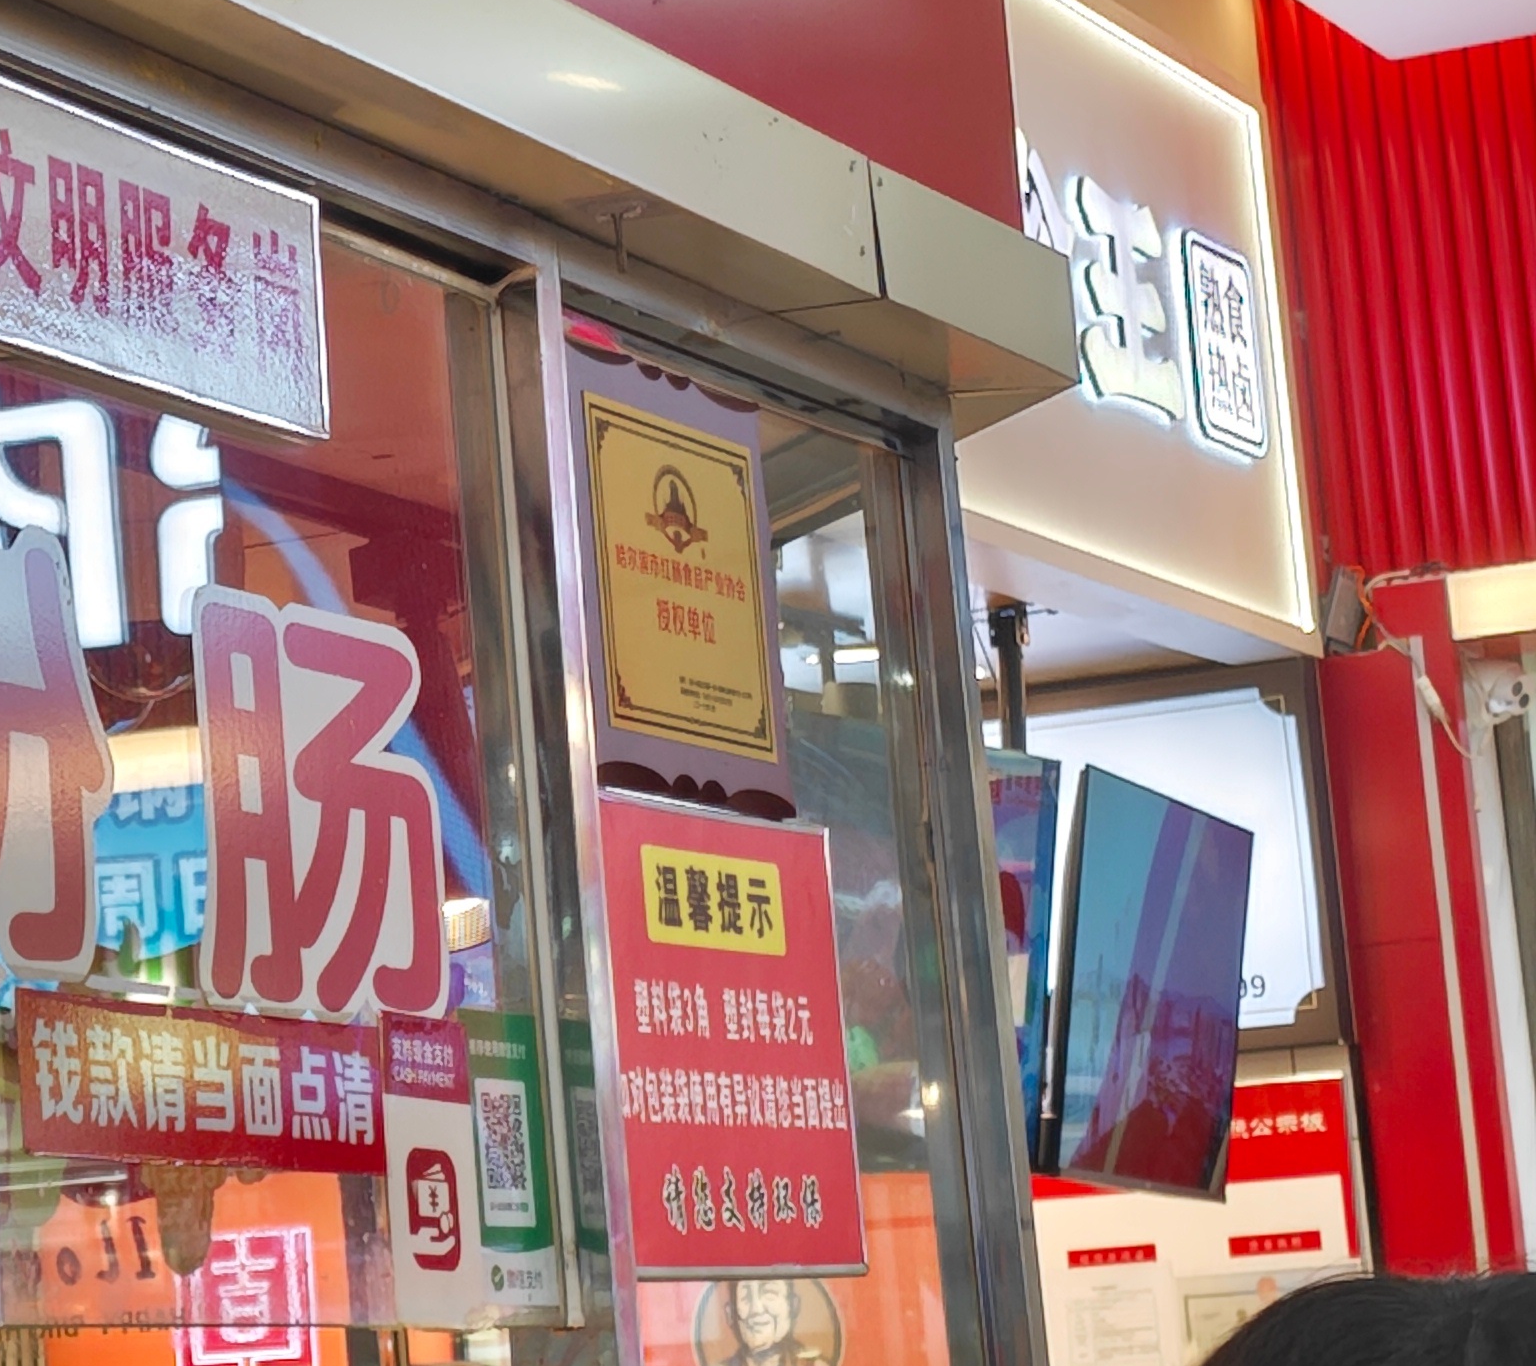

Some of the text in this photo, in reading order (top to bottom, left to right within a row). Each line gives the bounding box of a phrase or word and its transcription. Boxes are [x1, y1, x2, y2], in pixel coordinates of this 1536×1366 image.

[656, 598, 717, 645] 授权单位
[655, 862, 774, 939] 温馨提示
[633, 979, 711, 1039] 塑料袋3角
[31, 1018, 375, 1146] 钱款请当面点清
[662, 1162, 824, 1235] 请您支持环保
